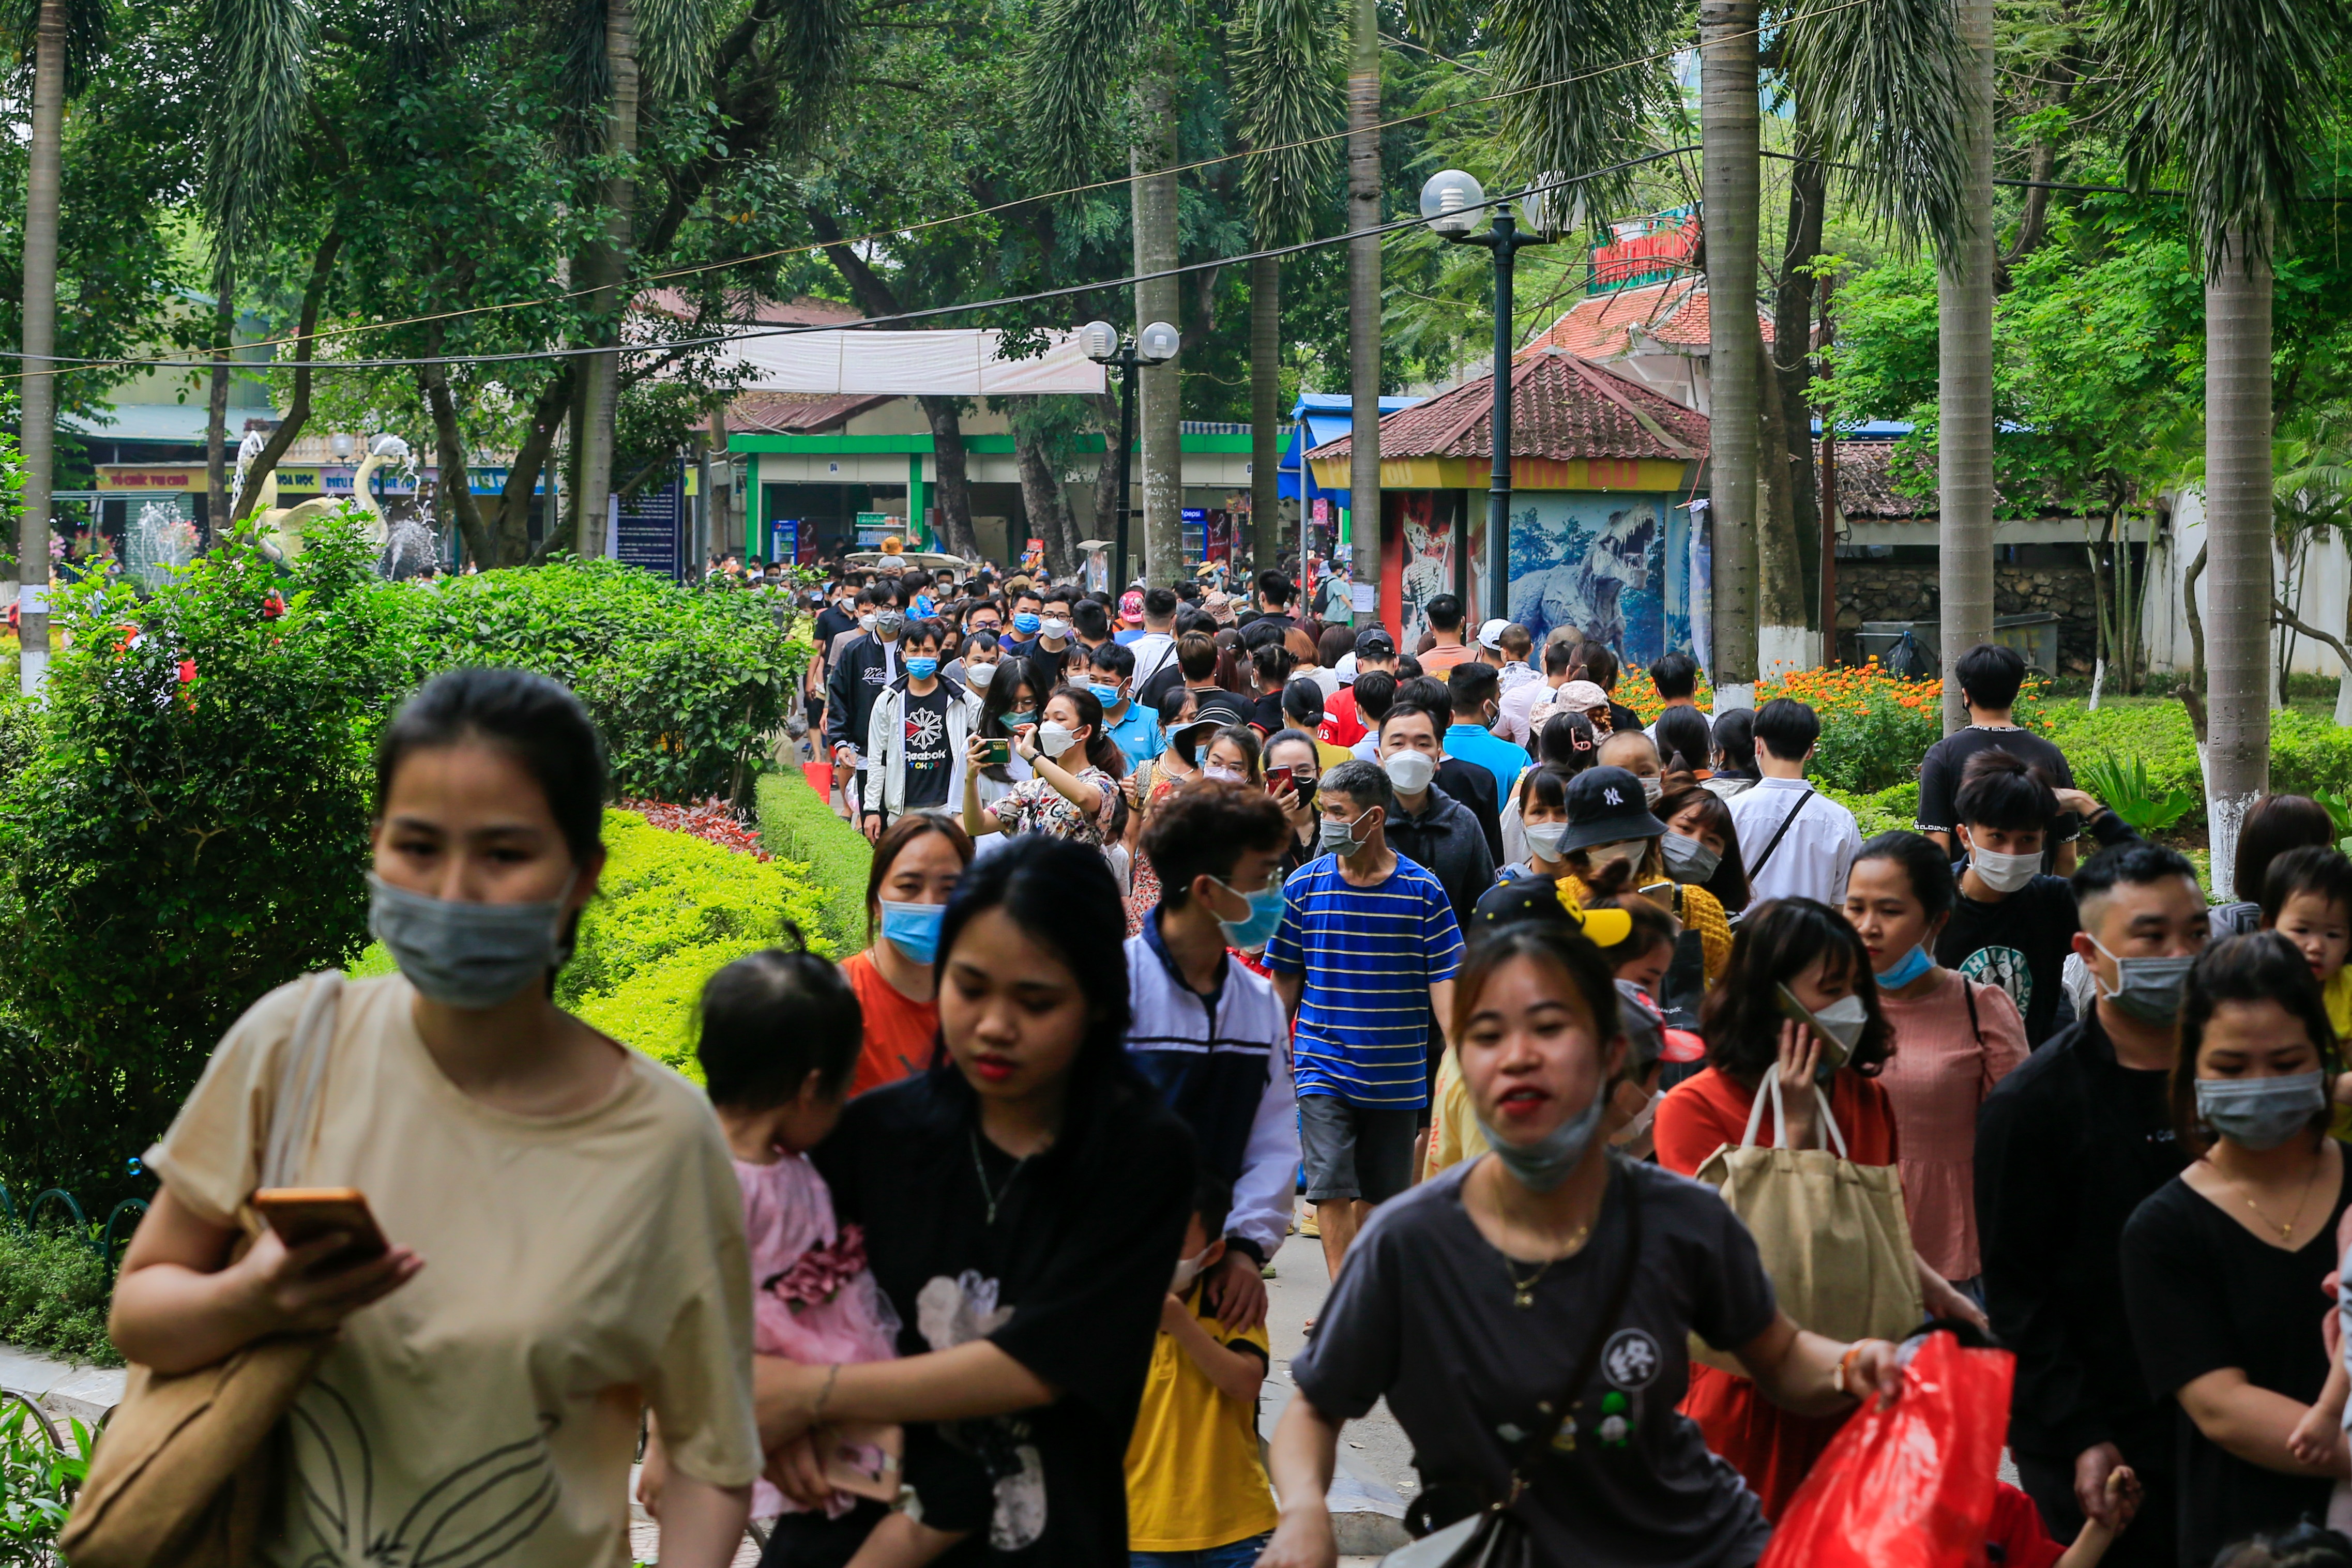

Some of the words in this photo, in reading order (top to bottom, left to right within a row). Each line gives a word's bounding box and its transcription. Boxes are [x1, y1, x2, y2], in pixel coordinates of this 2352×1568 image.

[1588, 458, 1638, 487] 6D
[905, 749, 947, 762] Reebok
[1603, 787, 1623, 805] NY
